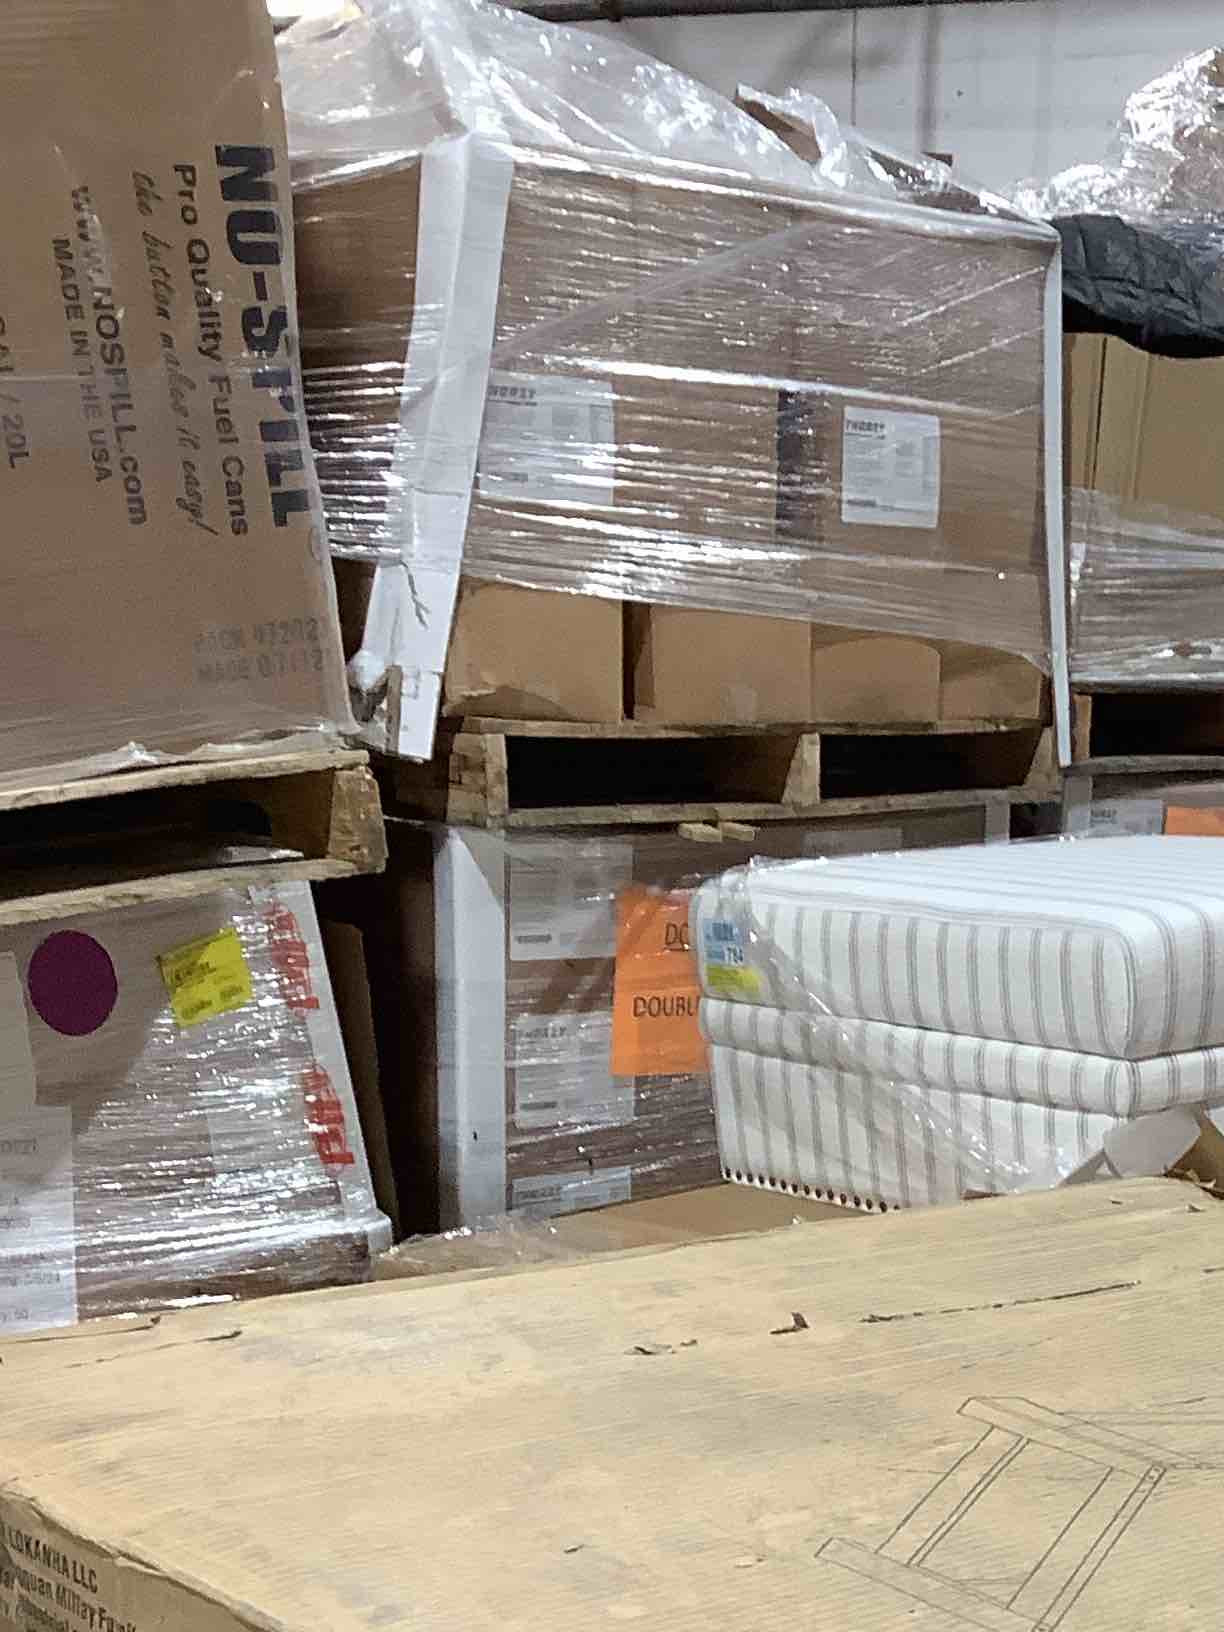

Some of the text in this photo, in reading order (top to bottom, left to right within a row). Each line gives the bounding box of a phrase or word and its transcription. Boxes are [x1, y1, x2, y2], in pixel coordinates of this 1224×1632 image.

[52, 238, 85, 321] MADE
[70, 330, 91, 357] IN
[88, 429, 113, 483] USA
[173, 164, 248, 537] Pro Quality Fuel Cans
[72, 1560, 99, 1593] LLC
